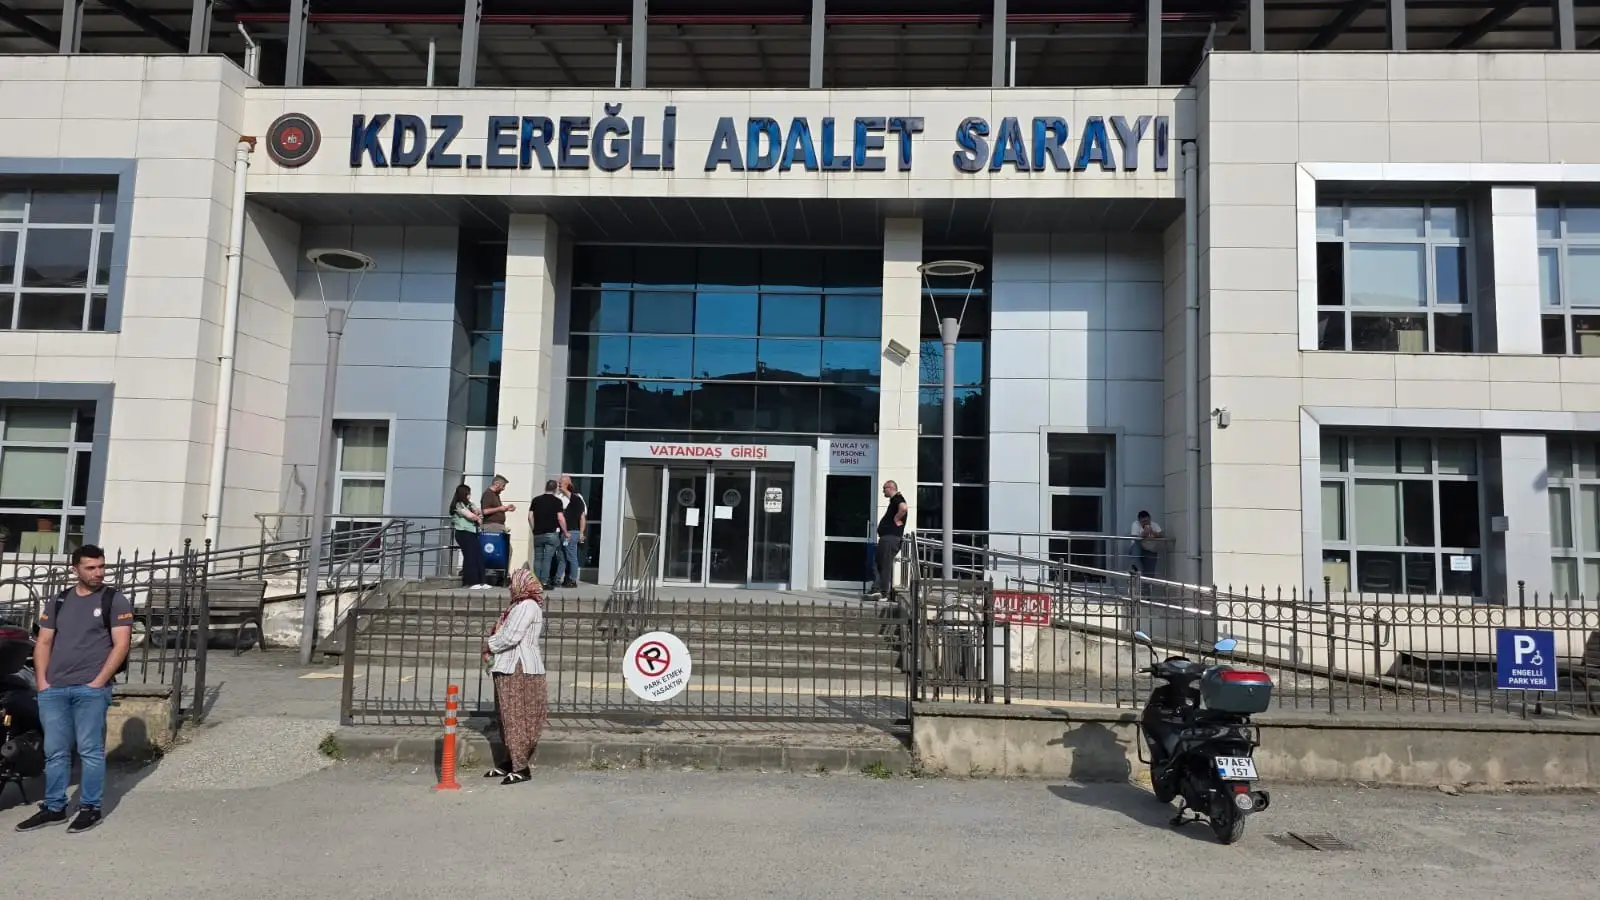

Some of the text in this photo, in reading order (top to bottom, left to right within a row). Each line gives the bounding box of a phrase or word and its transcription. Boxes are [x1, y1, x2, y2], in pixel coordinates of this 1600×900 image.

[350, 103, 1169, 172] KDZ.EREĞLİ ADALET SARAYI
[650, 445, 768, 460] VATANDAŞ GİRİŞİ
[1514, 635, 1535, 664] P
[1512, 668, 1543, 676] ENGELLİ
[643, 668, 684, 692] PARK ETMEK
[651, 678, 684, 697] YASAKTIR
[1508, 677, 1547, 685] PARK YERİ
[1218, 758, 1251, 766] 67 AEY
[1231, 768, 1248, 776] 157
